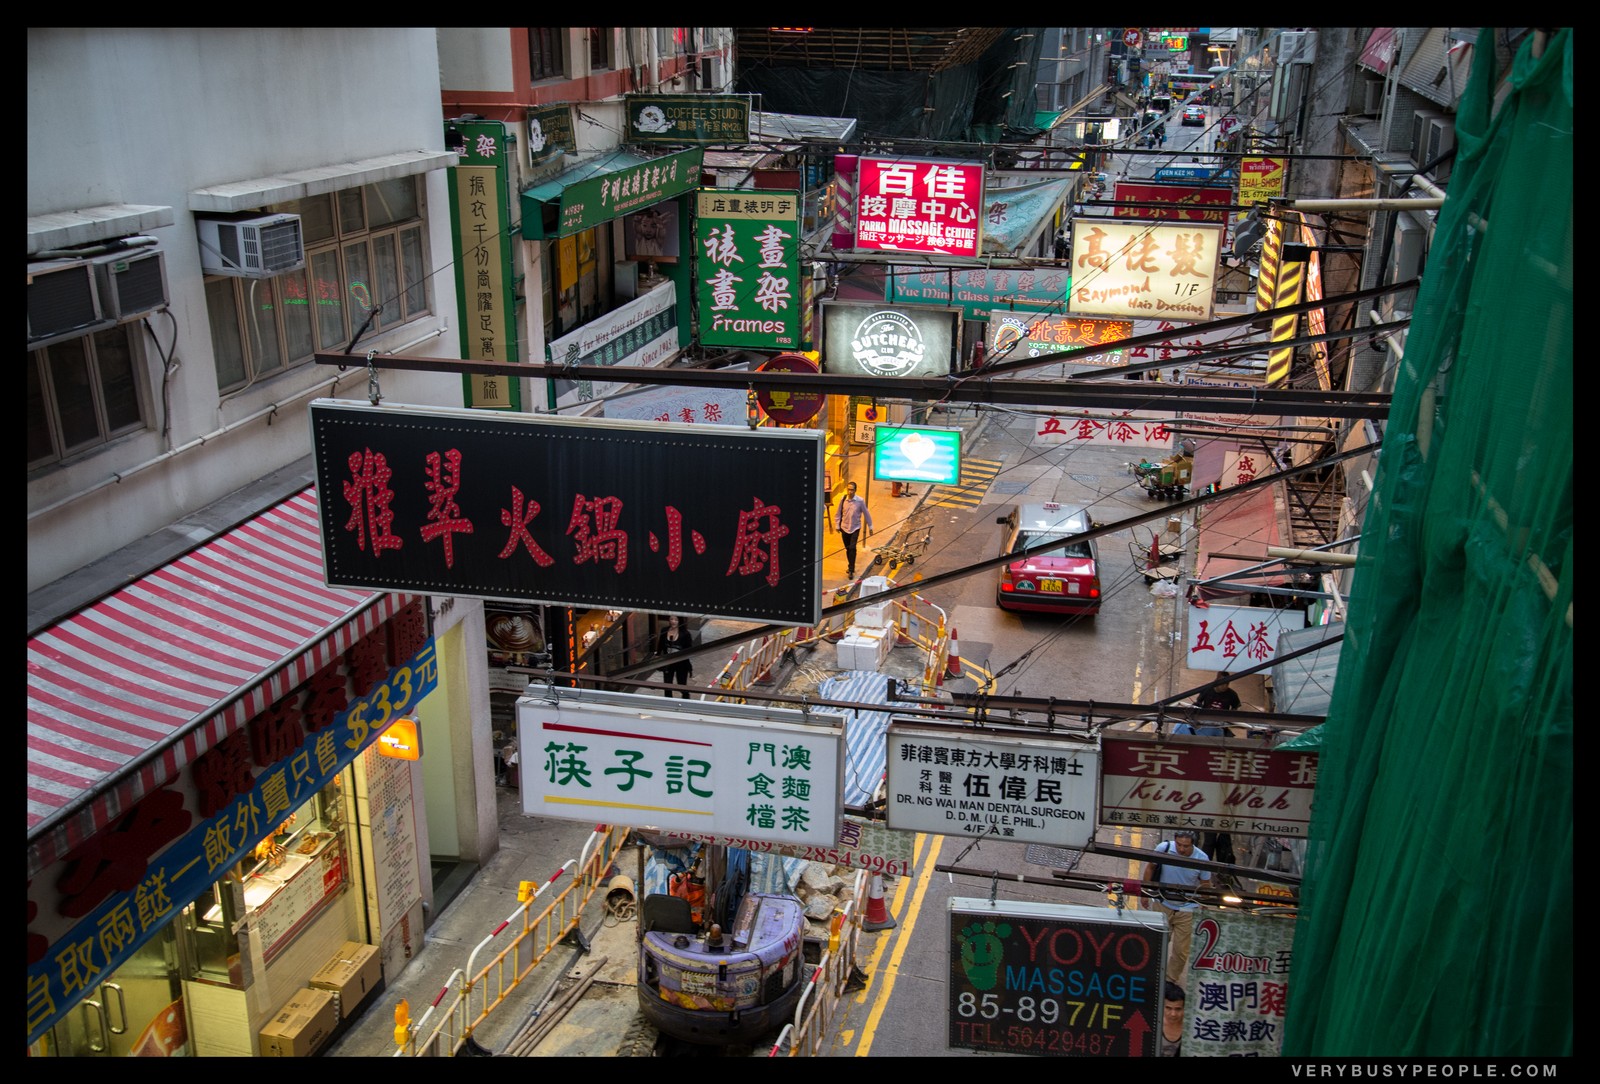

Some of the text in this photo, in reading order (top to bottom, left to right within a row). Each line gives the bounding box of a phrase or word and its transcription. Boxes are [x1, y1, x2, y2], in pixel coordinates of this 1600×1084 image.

[667, 106, 743, 121] COFFEE STUDIO
[877, 162, 966, 200] 百佳
[1241, 178, 1281, 188] THAI SHOP
[861, 195, 977, 223] 按摩中心
[859, 219, 976, 239] PARKA MASSAGE CENTRE
[896, 286, 919, 298] Yue
[958, 291, 989, 303] Glass
[1076, 275, 1200, 304] Raymond 1/F
[1128, 297, 1205, 316] Hair Dressing
[711, 314, 786, 334] Frames
[880, 323, 895, 333] The
[851, 333, 926, 355] BUTCHERS
[642, 350, 658, 367] Since
[1190, 619, 1276, 662] 五金漆
[543, 740, 714, 799] 筷子記
[900, 743, 1084, 776] 菲律賓東方大學牙科博士
[962, 773, 1063, 805] 伍偉民
[1129, 780, 1290, 811] King Wah
[896, 794, 915, 804] DR.
[917, 796, 933, 806] NG
[935, 797, 957, 809] WAI
[959, 799, 985, 812] MAN
[964, 824, 986, 834] 4/F
[1219, 819, 1247, 830] 8/F
[1251, 821, 1300, 834] Khuan
[860, 854, 909, 877] 9961
[1019, 924, 1150, 972] YOYO
[1006, 965, 1147, 1004] MASSAGE
[957, 991, 1125, 1030] 85-89 7/F
[1193, 1017, 1276, 1043] 送熱飲
